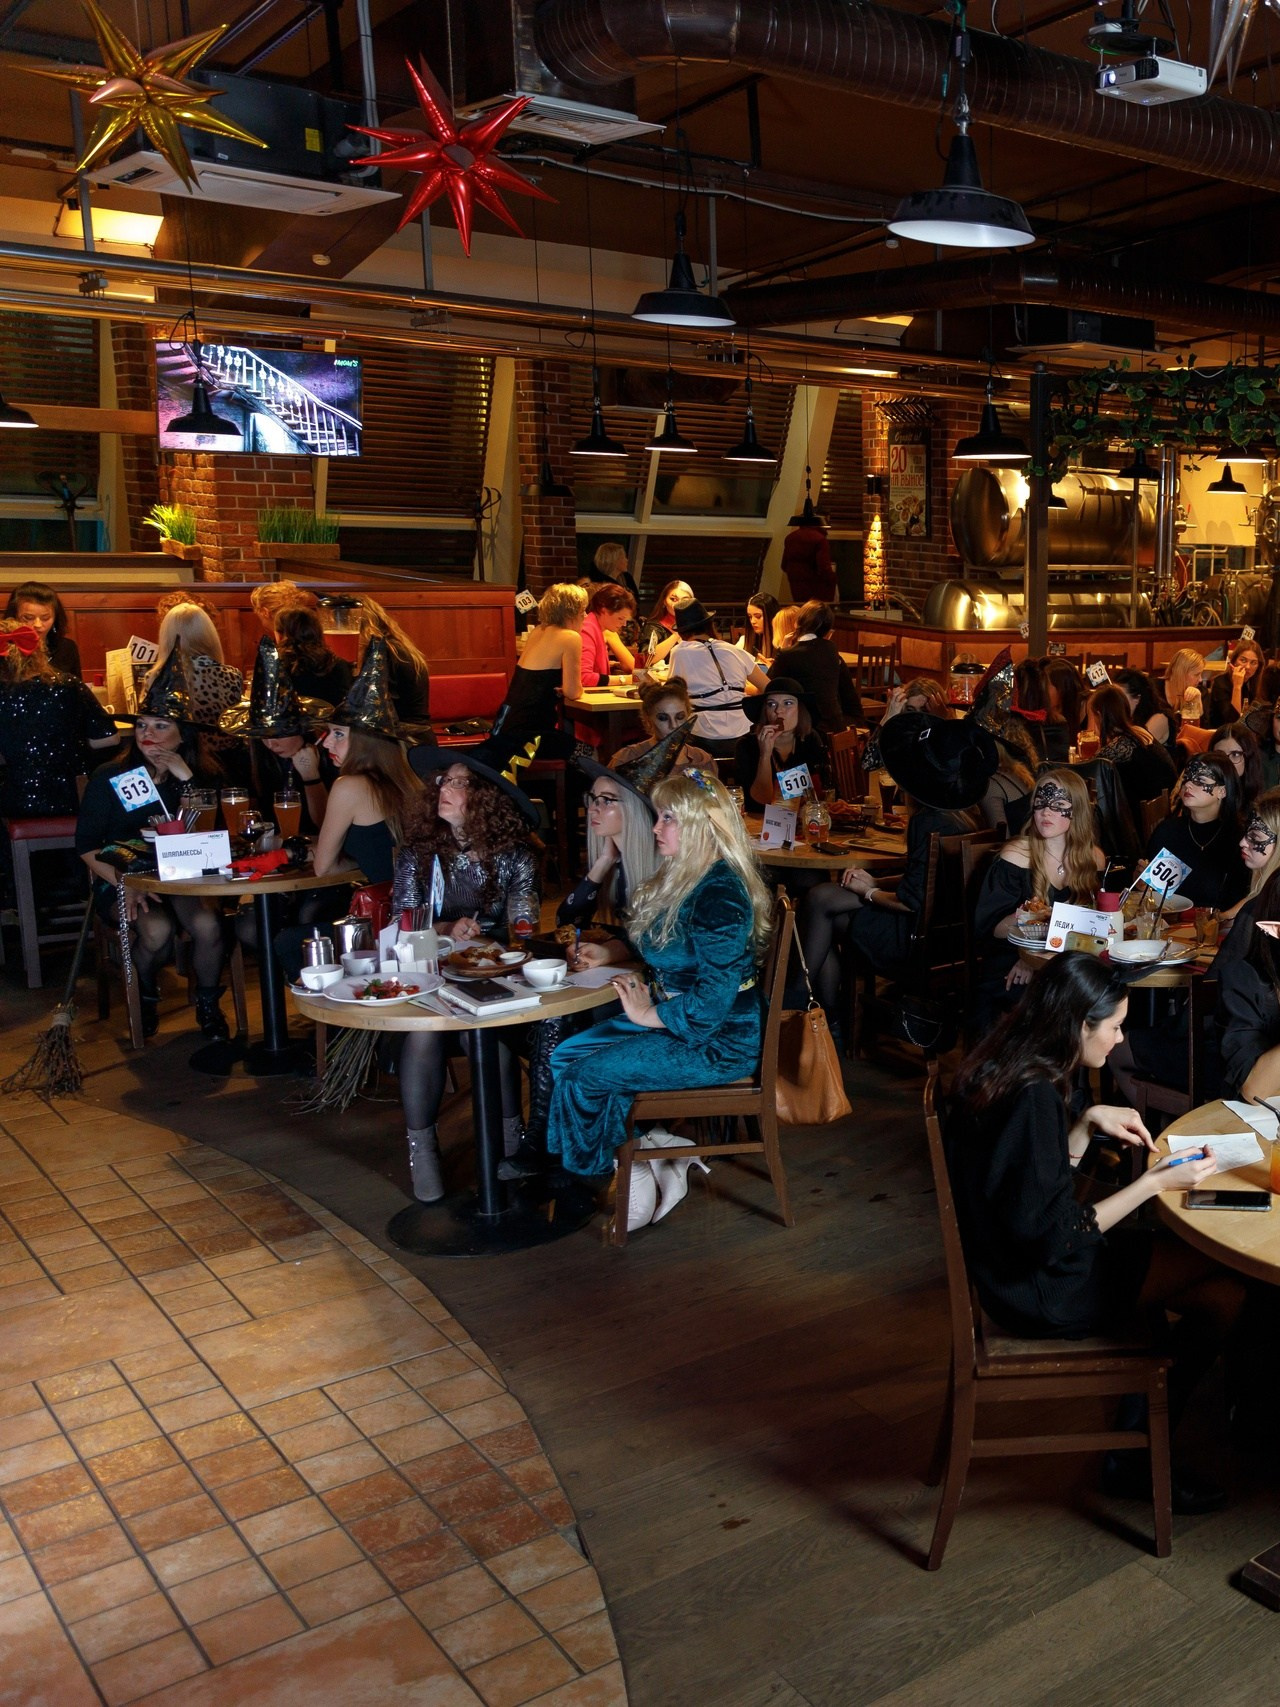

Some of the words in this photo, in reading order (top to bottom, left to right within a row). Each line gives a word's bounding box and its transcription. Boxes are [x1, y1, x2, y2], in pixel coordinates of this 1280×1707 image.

[891, 446, 907, 473] 20
[518, 596, 532, 608] 103
[131, 643, 155, 663] 101
[121, 780, 149, 800] 513
[785, 775, 807, 791] 510
[1152, 862, 1178, 887] 504
[1054, 920, 1070, 930] ЛЕДИ
